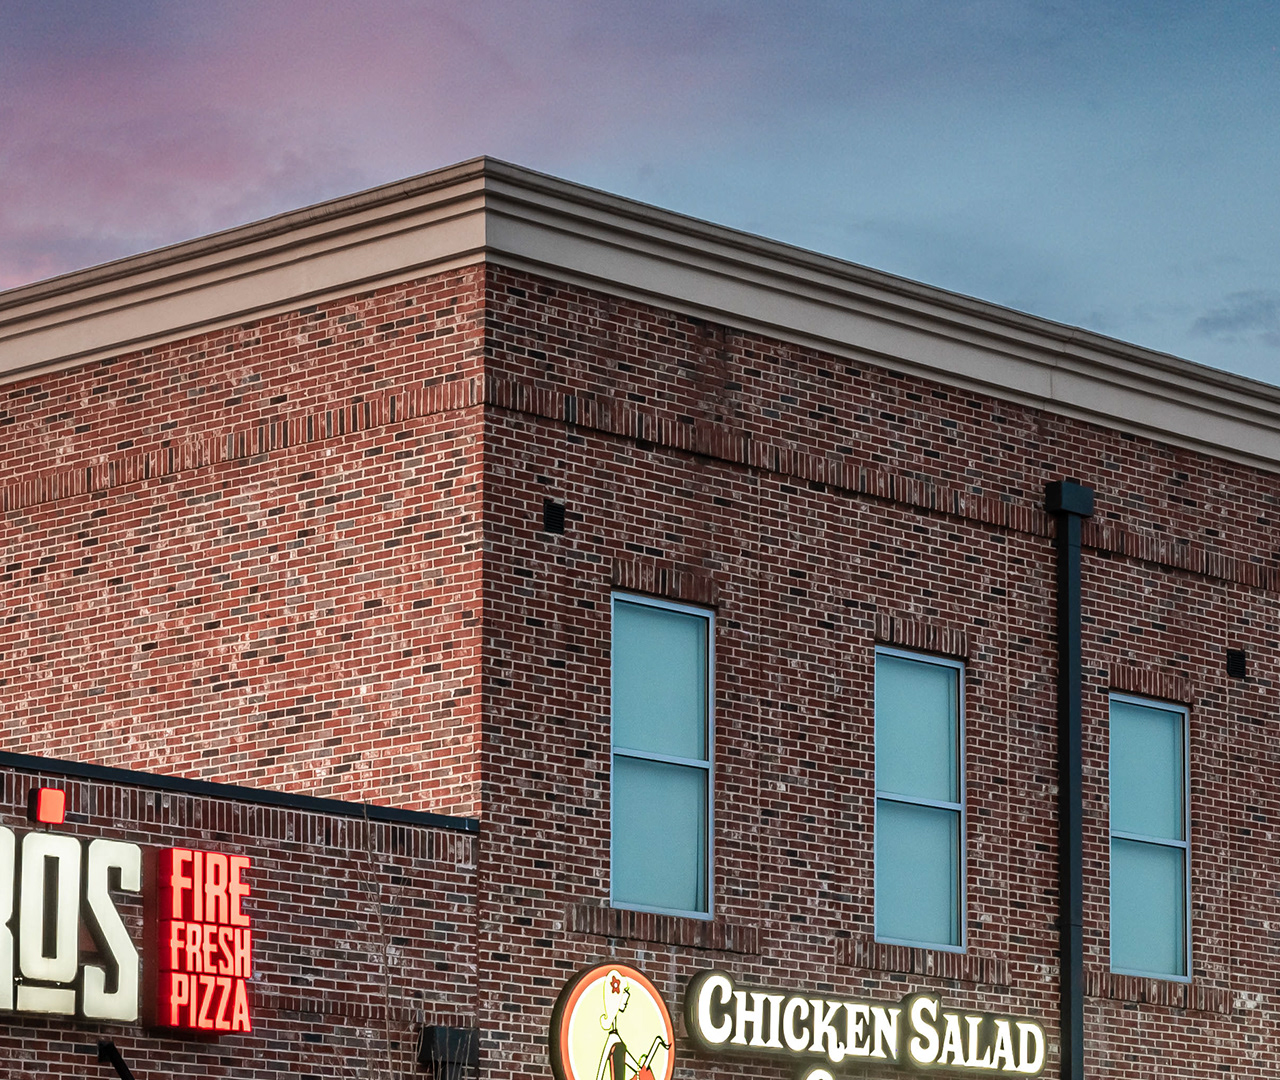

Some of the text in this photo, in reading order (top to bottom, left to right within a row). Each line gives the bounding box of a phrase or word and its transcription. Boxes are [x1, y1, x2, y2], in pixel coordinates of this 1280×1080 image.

[169, 849, 251, 926] FIRE
[169, 920, 251, 979] FRESH
[169, 973, 251, 1032] PIZZA
[698, 975, 1045, 1074] CHICKEN SALAD
